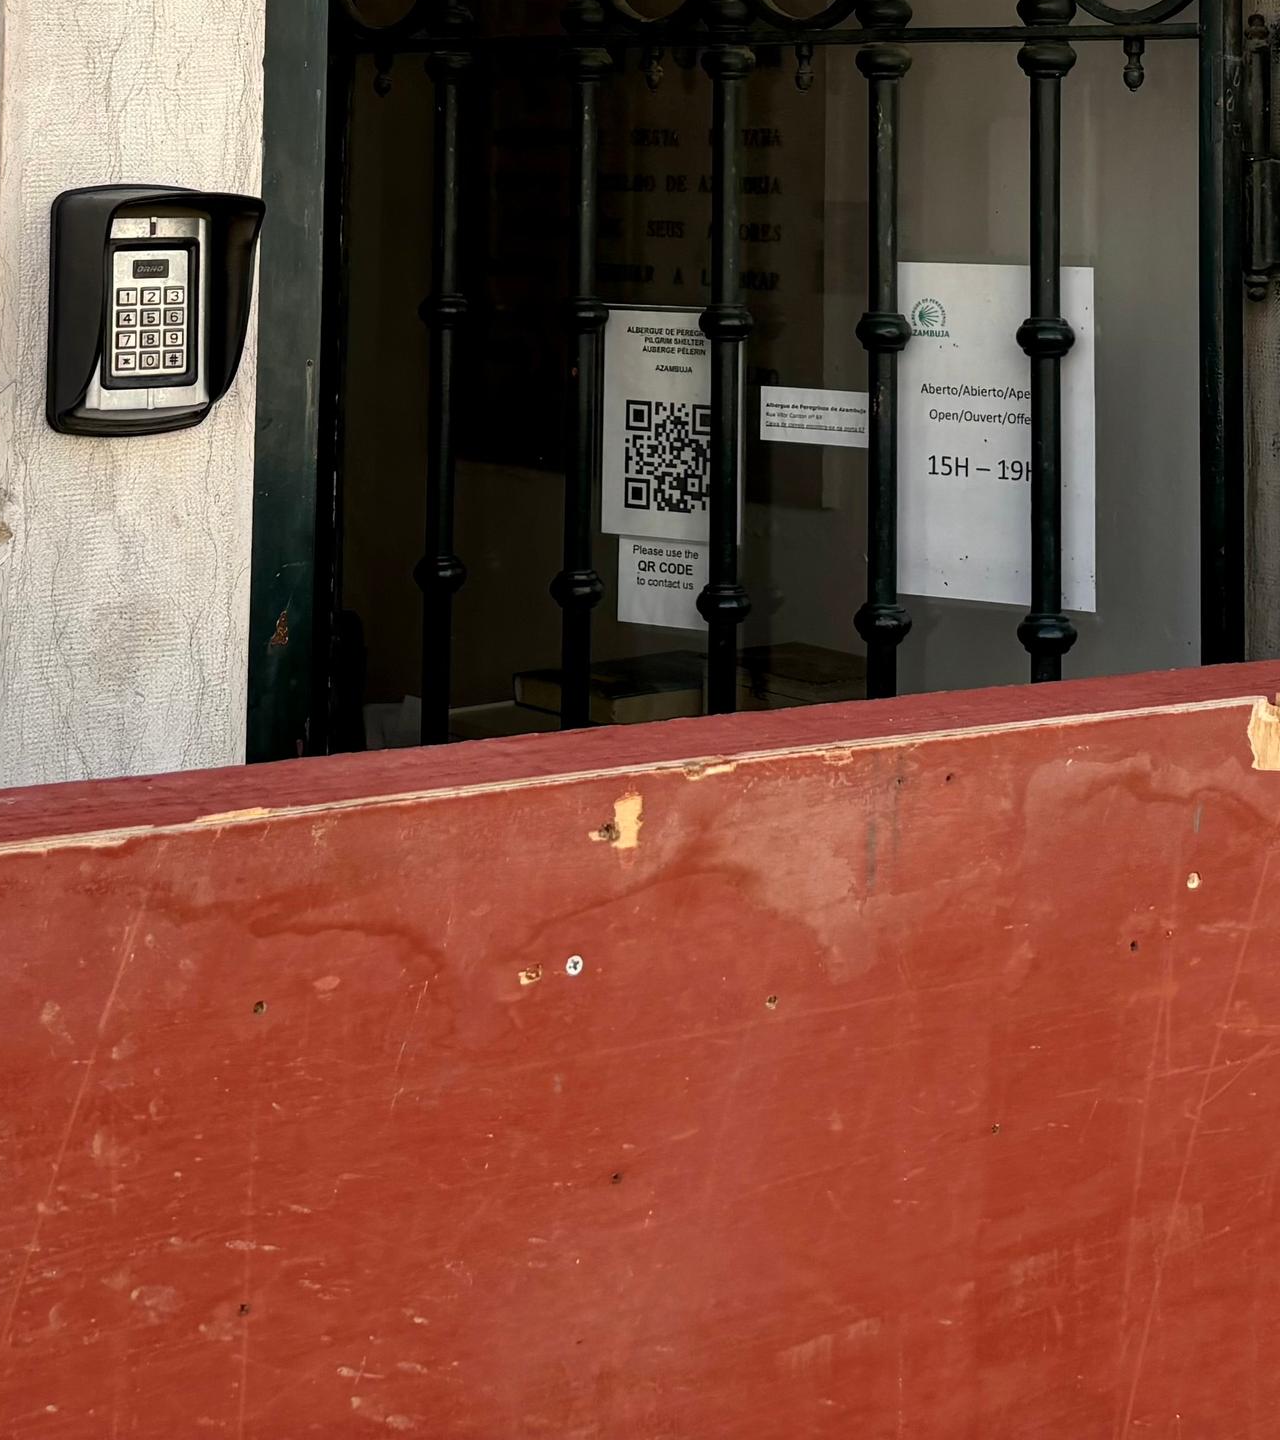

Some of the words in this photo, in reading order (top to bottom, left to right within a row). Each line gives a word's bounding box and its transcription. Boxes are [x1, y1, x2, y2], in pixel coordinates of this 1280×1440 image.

[912, 329, 950, 338] ZAMBUJA
[920, 383, 1031, 401] Aberto/Abierto/Ape
[929, 408, 1031, 425] Open/Ouvert/Offe
[928, 455, 969, 478] 15H
[632, 544, 664, 557] Please
[666, 548, 682, 558] use
[685, 550, 699, 560] the
[638, 560, 656, 573] QR
[659, 562, 694, 576] CODE
[636, 576, 646, 586] to
[647, 578, 681, 589] contact
[682, 581, 694, 590] us
